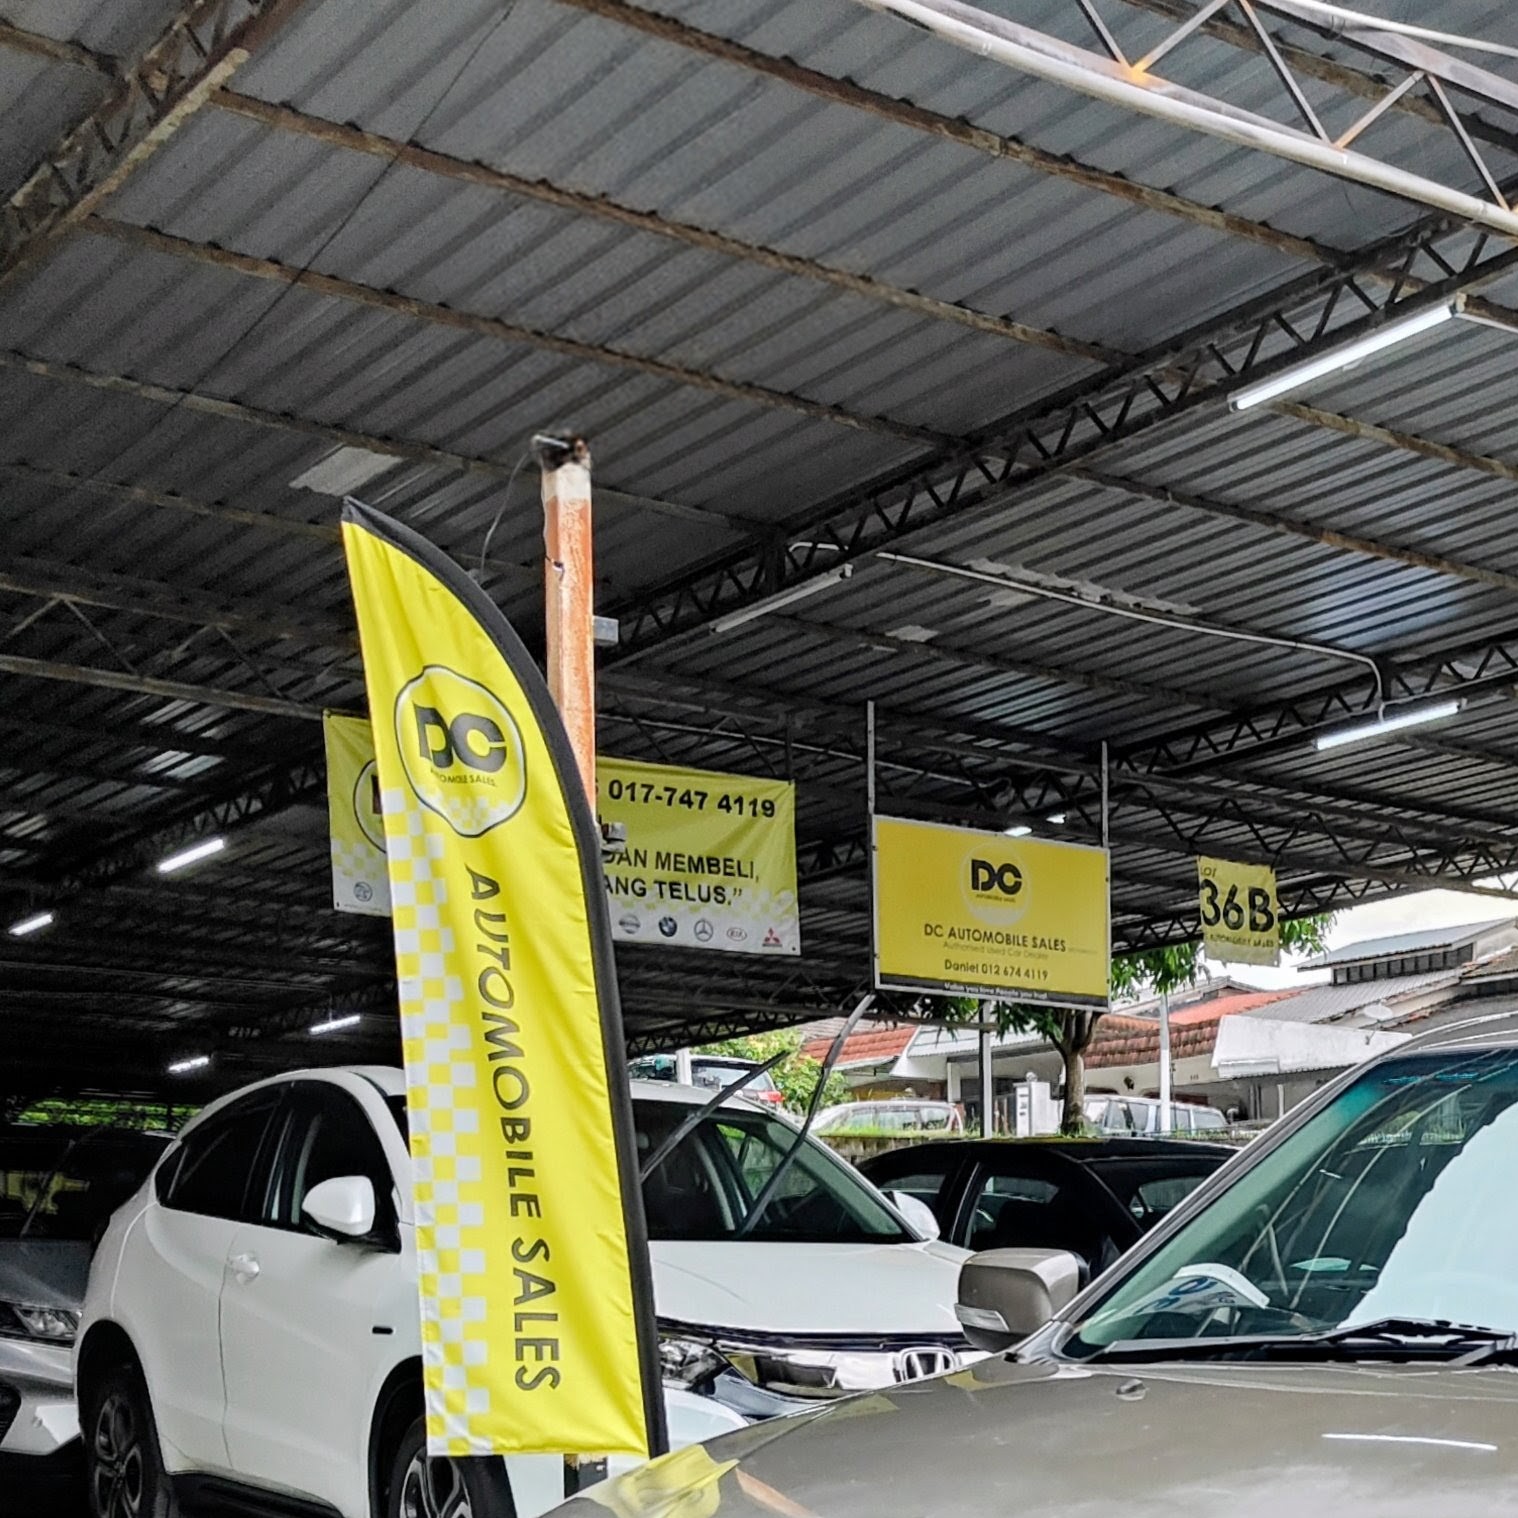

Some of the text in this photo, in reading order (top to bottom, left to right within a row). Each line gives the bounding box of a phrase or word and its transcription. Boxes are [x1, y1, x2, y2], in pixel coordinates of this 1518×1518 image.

[412, 700, 508, 773] DC
[608, 779, 708, 811] 017-747
[717, 794, 776, 818] 4119
[655, 851, 760, 883] MEMBELI,
[970, 858, 1023, 894] DC
[1200, 878, 1275, 933] 36B
[923, 923, 944, 939] DC
[947, 926, 1029, 949] AUTOMOBILE
[1031, 936, 1067, 953] SALES
[944, 959, 1049, 982] Daniel 012 674 4119
[464, 863, 562, 1392] AUTOMOBILE SALES
